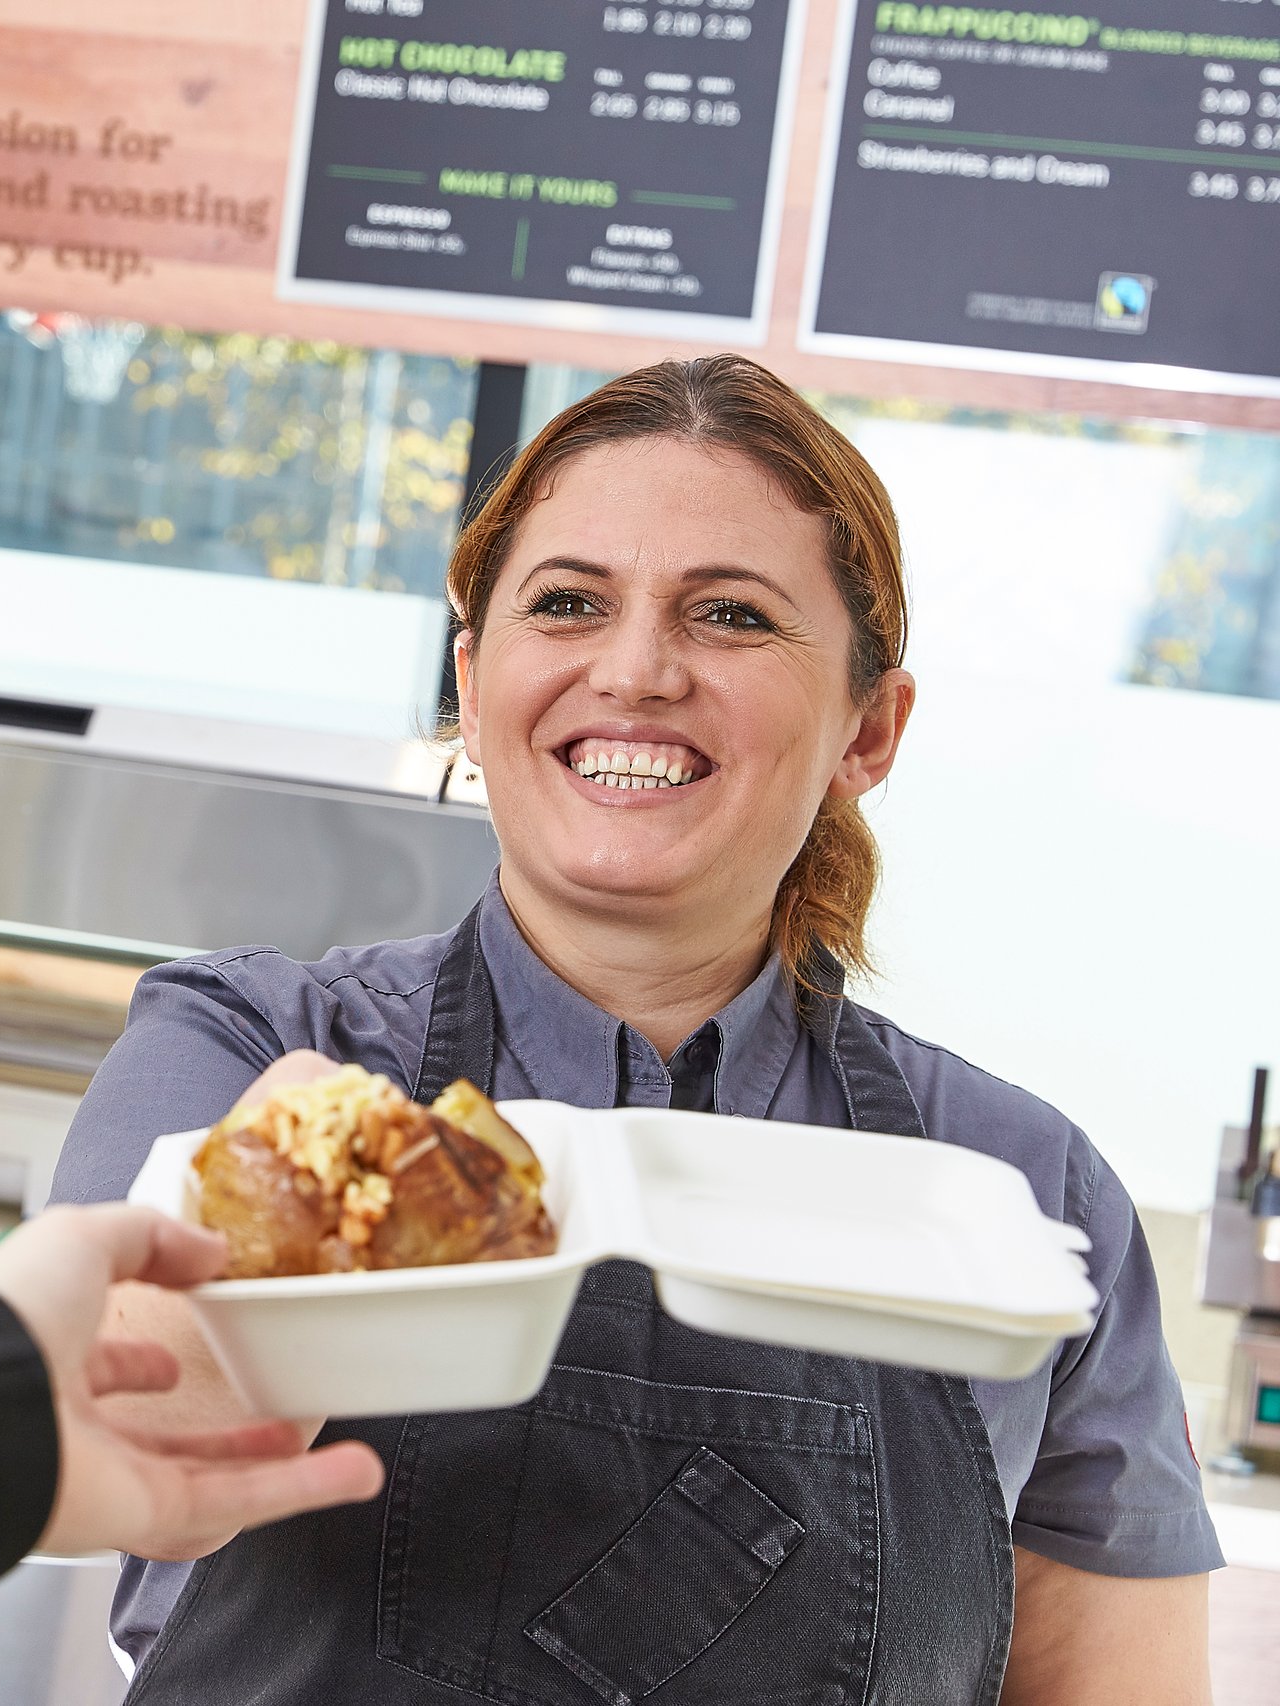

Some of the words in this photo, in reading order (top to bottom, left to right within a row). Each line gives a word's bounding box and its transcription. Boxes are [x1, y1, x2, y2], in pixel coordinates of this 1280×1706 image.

[340, 37, 398, 70] HOT
[401, 41, 566, 81] CHOCOLATE
[868, 59, 941, 90] Coffee
[335, 69, 406, 100] Classic
[408, 74, 448, 102] Hot
[449, 78, 550, 111] Chocolate
[864, 90, 955, 122] Caramel
[100, 118, 173, 165] for
[858, 141, 990, 178] Strawberries
[989, 147, 1036, 179] and
[1035, 154, 1109, 188] Cream
[66, 178, 272, 241] roasting
[440, 169, 509, 198] MAKE
[510, 175, 538, 200] IT
[537, 176, 617, 208] YOURS
[51, 240, 154, 284] cup.
